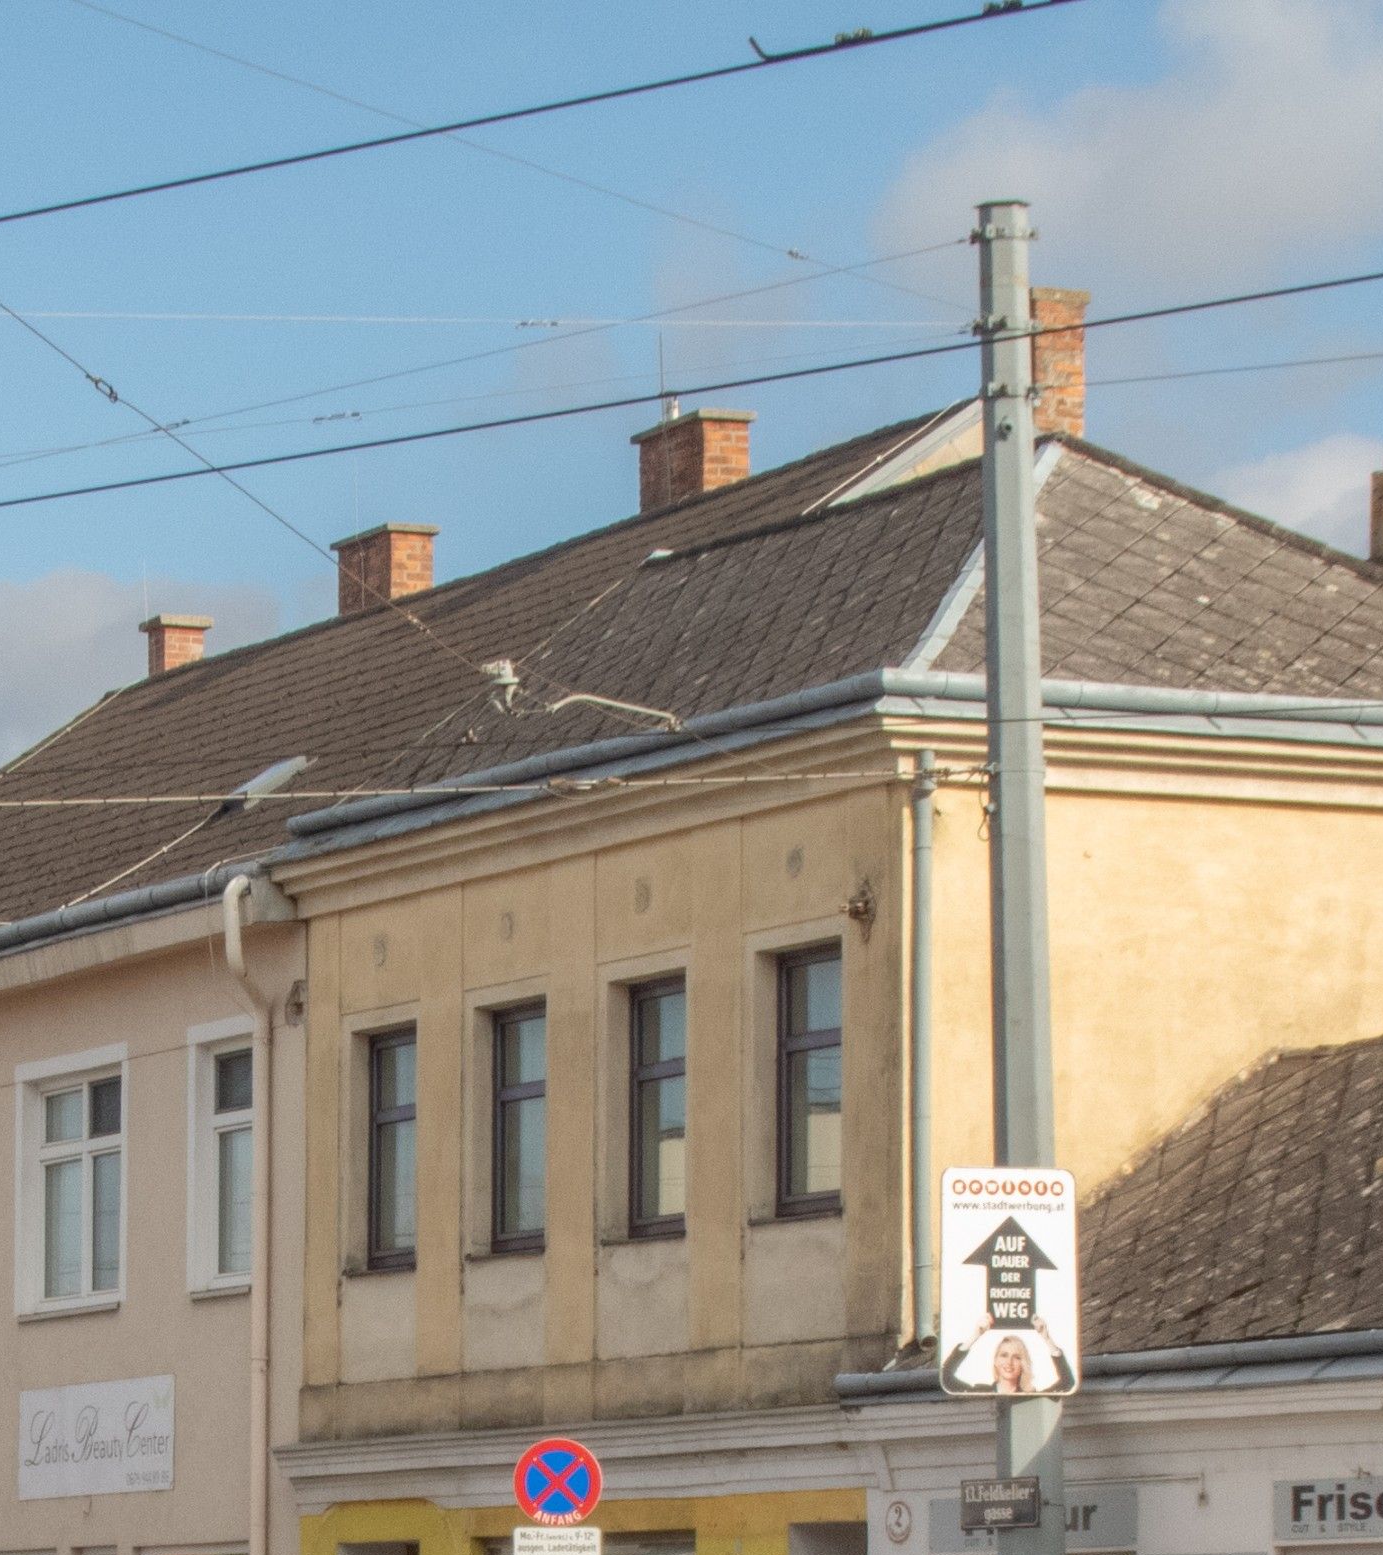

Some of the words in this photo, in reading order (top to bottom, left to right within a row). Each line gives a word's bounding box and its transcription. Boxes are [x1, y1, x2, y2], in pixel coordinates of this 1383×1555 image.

[953, 1201, 1065, 1214] www.stadtwerbung.at
[994, 1236, 1026, 1252] AUF
[992, 1255, 1029, 1268] DAUER
[1001, 1272, 1020, 1283] DER
[990, 1288, 1031, 1299] RICHTIGE
[993, 1303, 1028, 1318] WEG
[71, 1405, 123, 1463] Beauty
[124, 1401, 169, 1458] Center
[533, 1510, 582, 1526] ANFANG
